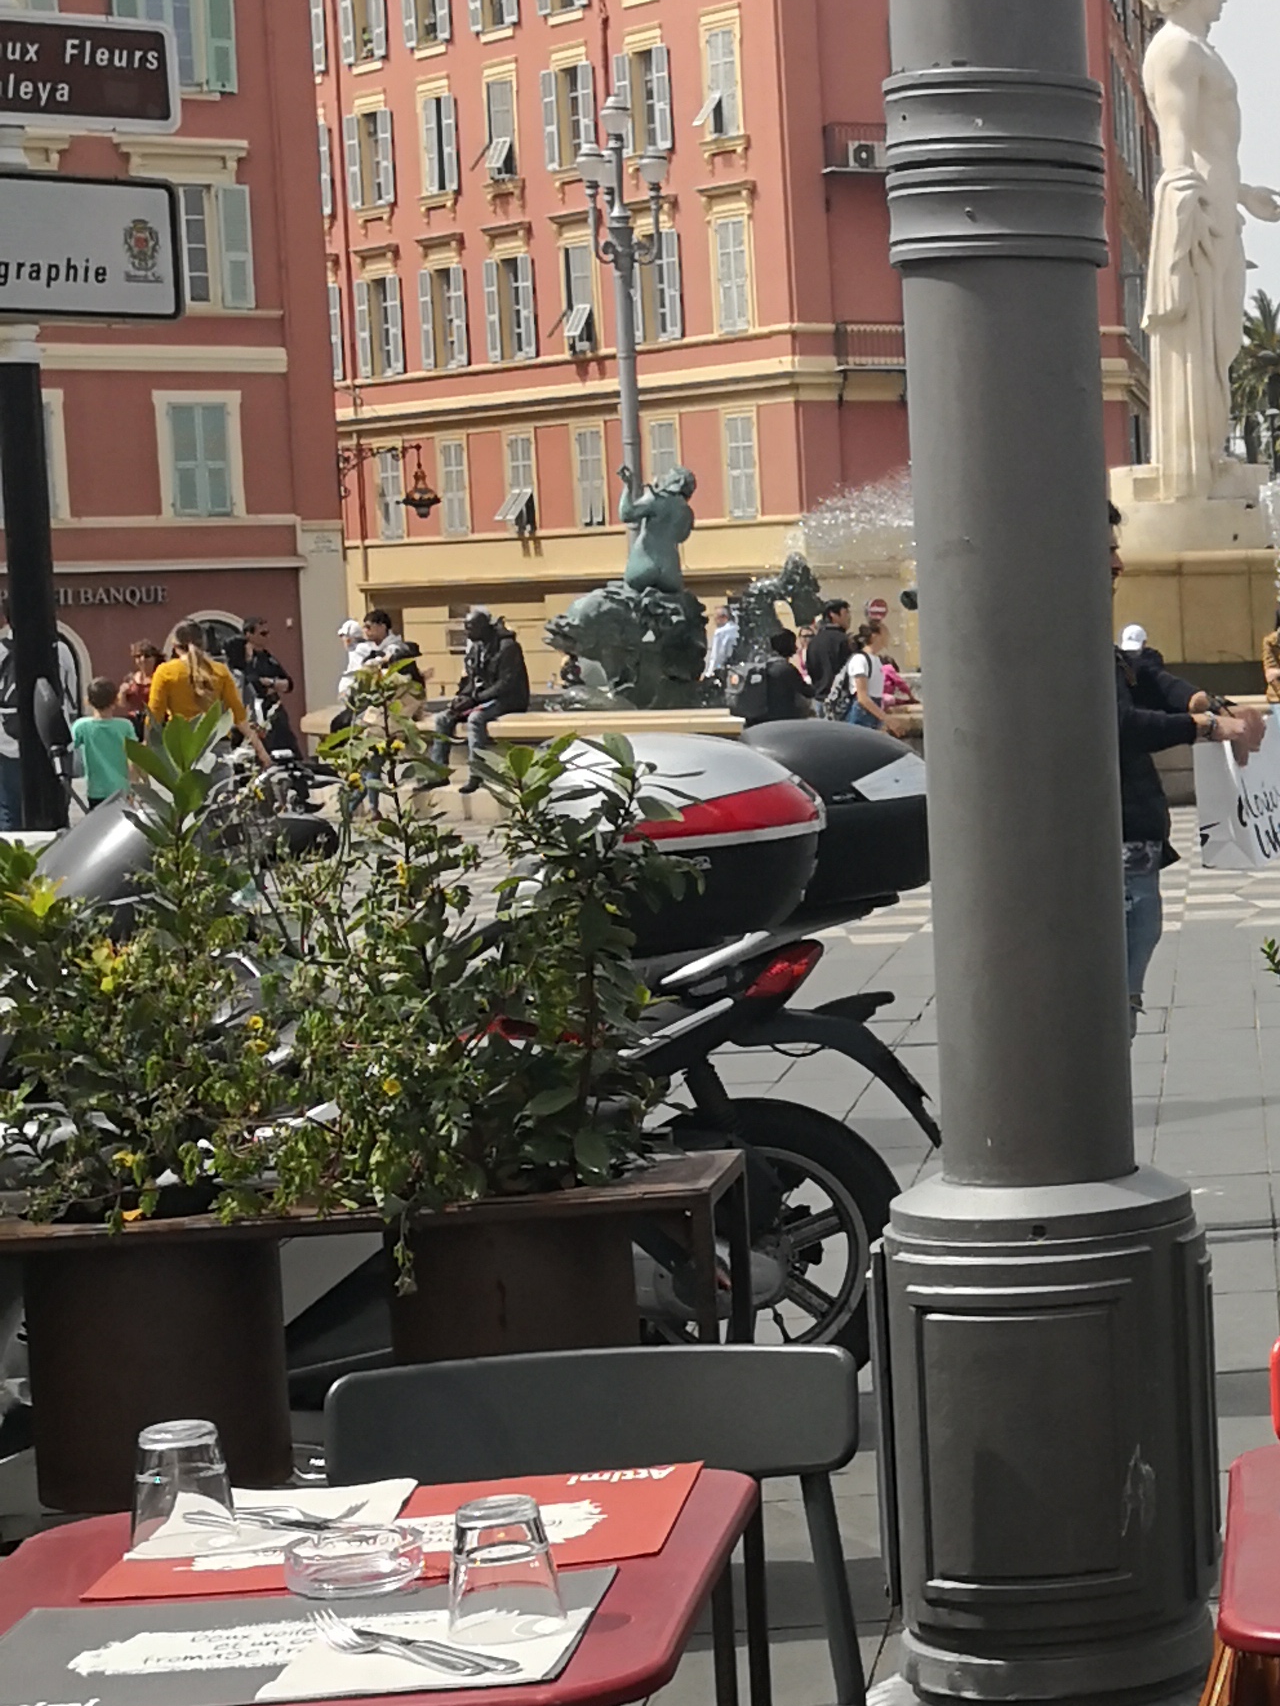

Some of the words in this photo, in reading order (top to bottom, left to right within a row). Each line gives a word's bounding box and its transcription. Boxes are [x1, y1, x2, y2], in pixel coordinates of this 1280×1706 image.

[0, 41, 38, 63] ux
[65, 39, 160, 69] Fleurs
[0, 73, 70, 107] leya
[80, 585, 169, 607] BANQUE
[566, 1465, 676, 1486] Attimi
